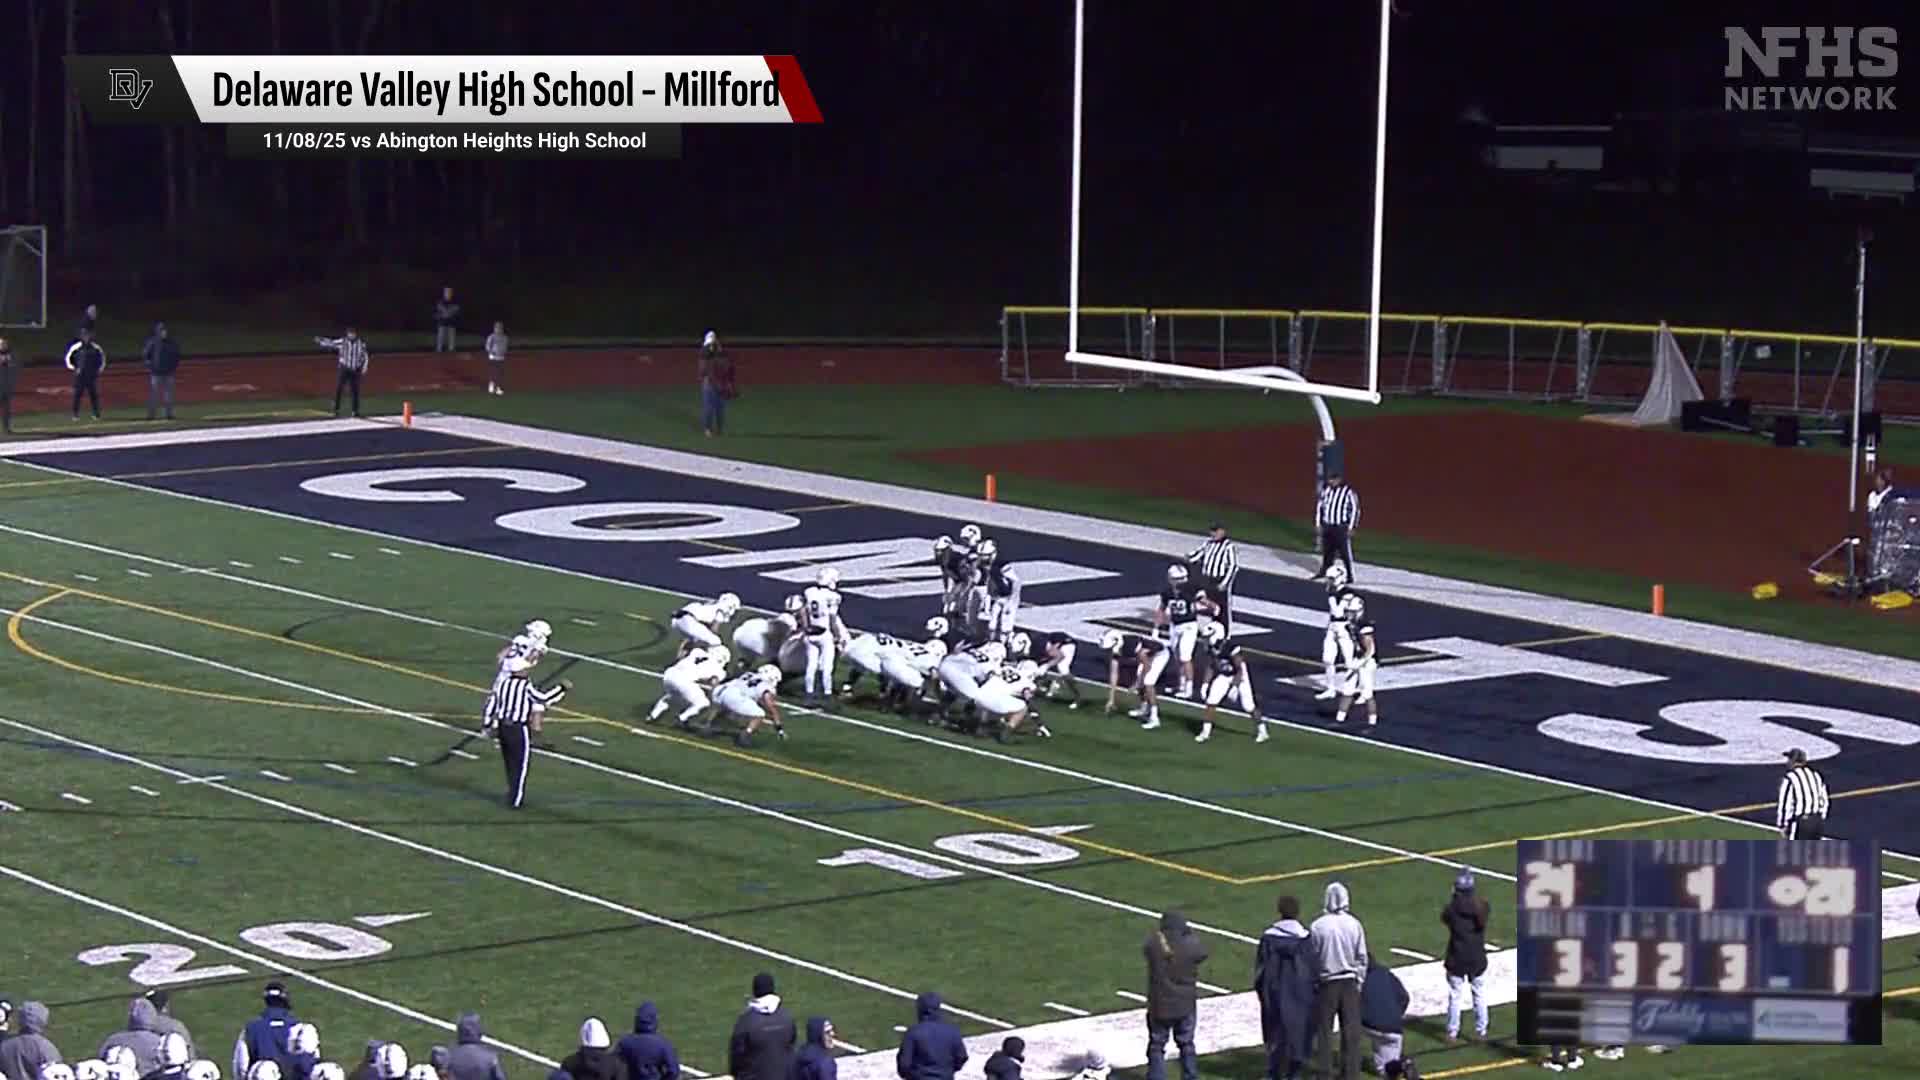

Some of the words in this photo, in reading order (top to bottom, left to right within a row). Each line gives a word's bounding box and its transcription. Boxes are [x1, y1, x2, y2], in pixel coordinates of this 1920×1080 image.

[300, 466, 1920, 766] COMETS
[816, 832, 1081, 880] 10
[77, 921, 393, 986] 20
[1553, 939, 1583, 988] 3
[1717, 943, 1747, 992] 3
